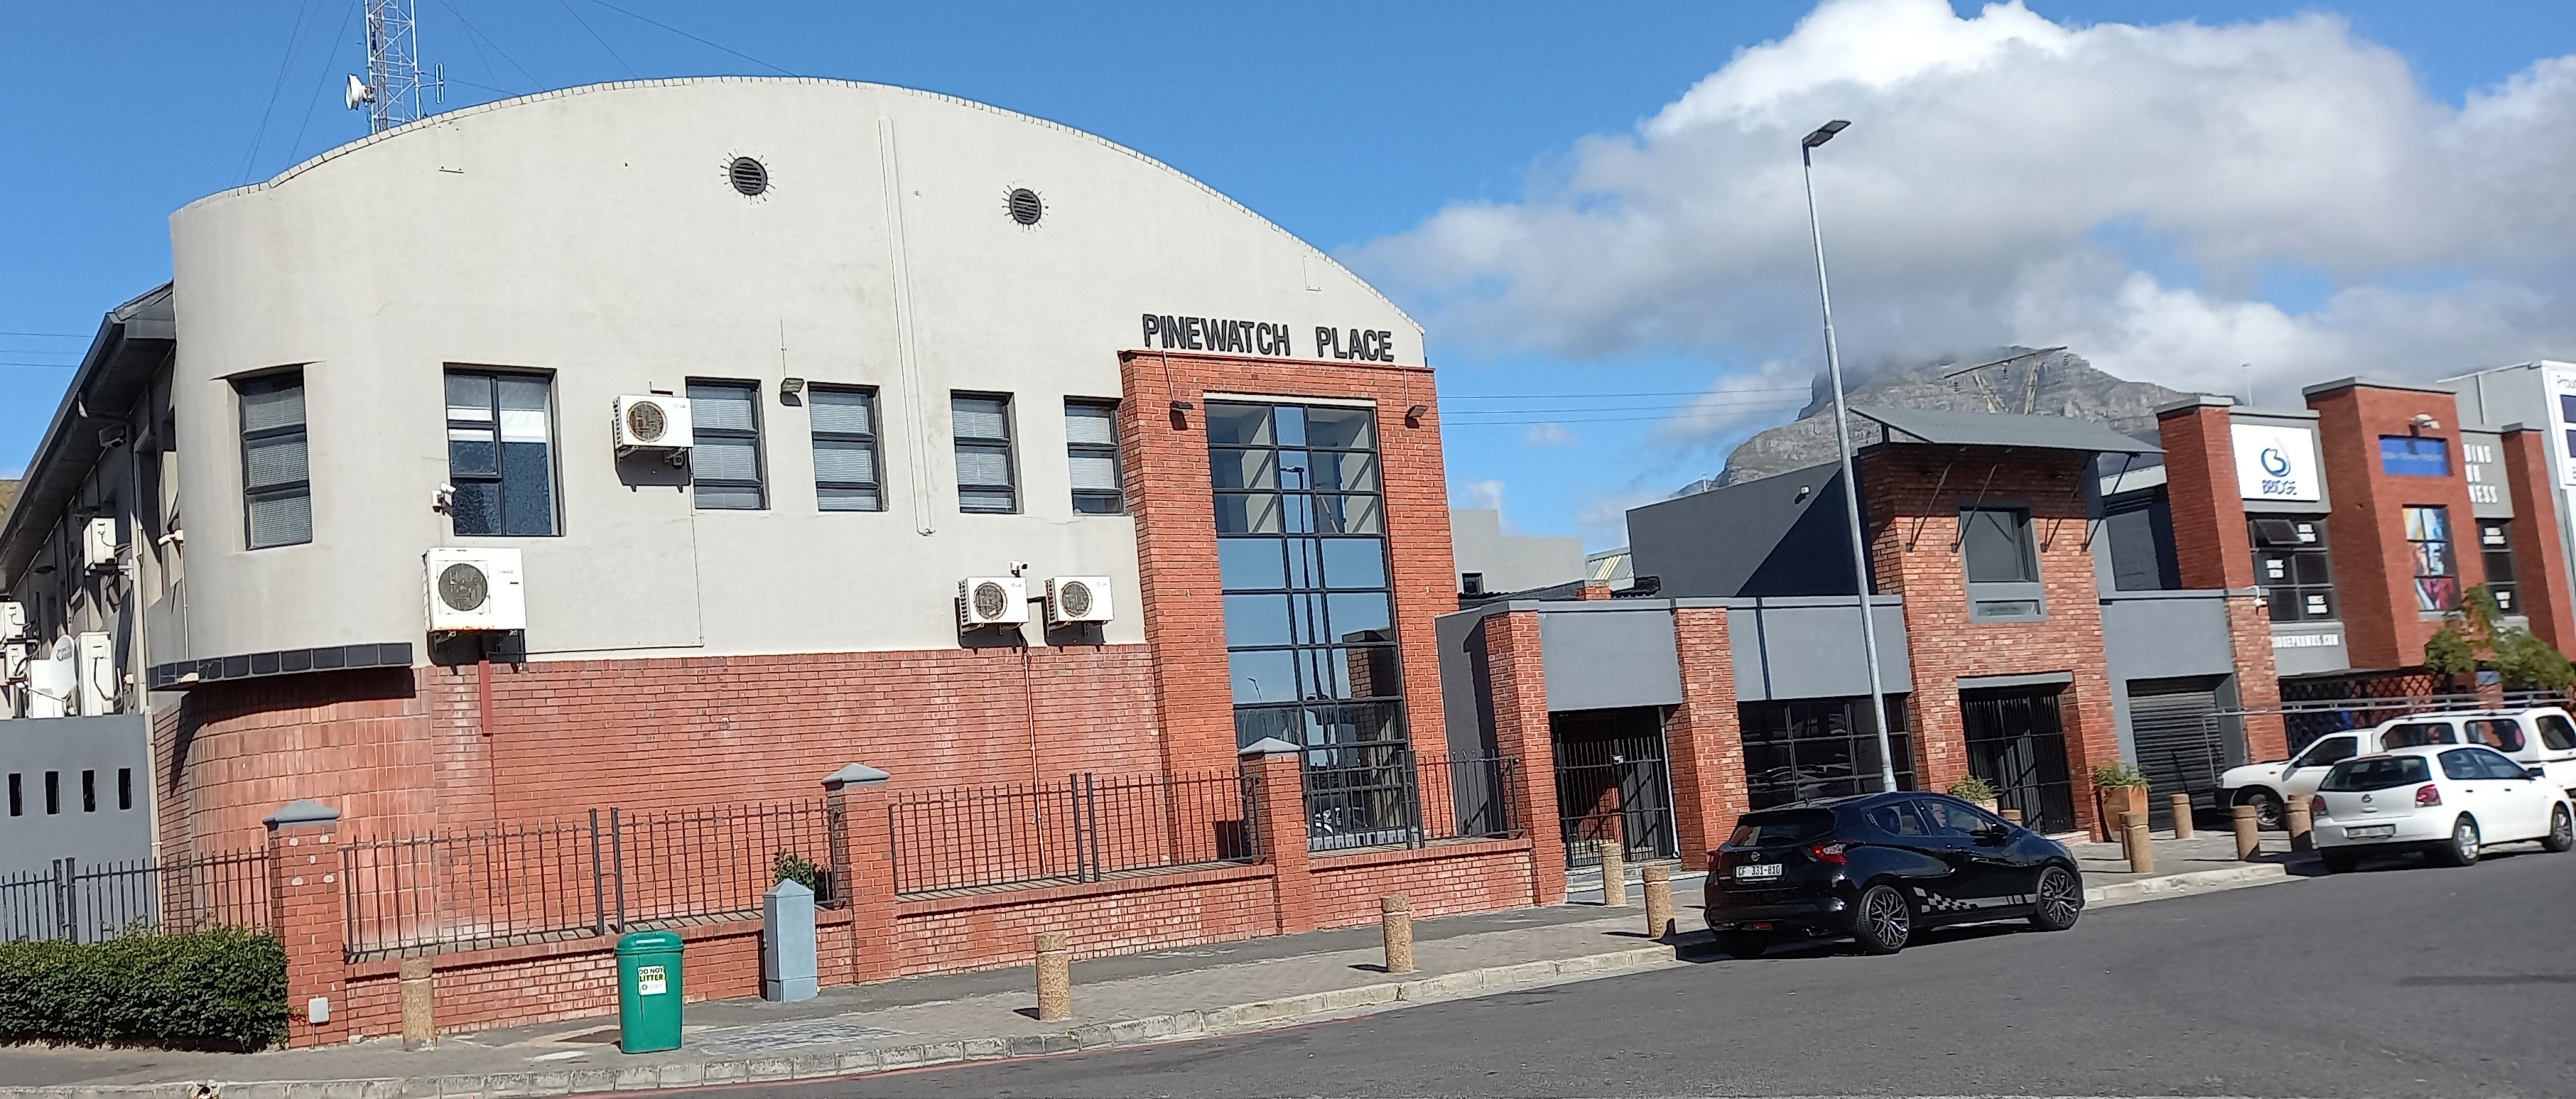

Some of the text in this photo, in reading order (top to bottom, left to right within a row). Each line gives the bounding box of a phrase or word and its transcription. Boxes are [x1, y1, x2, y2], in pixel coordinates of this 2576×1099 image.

[1142, 313, 1395, 362] PINEWATCH PLACE
[1738, 865, 1780, 876] CF 331-810
[639, 973, 664, 982] LITTER
